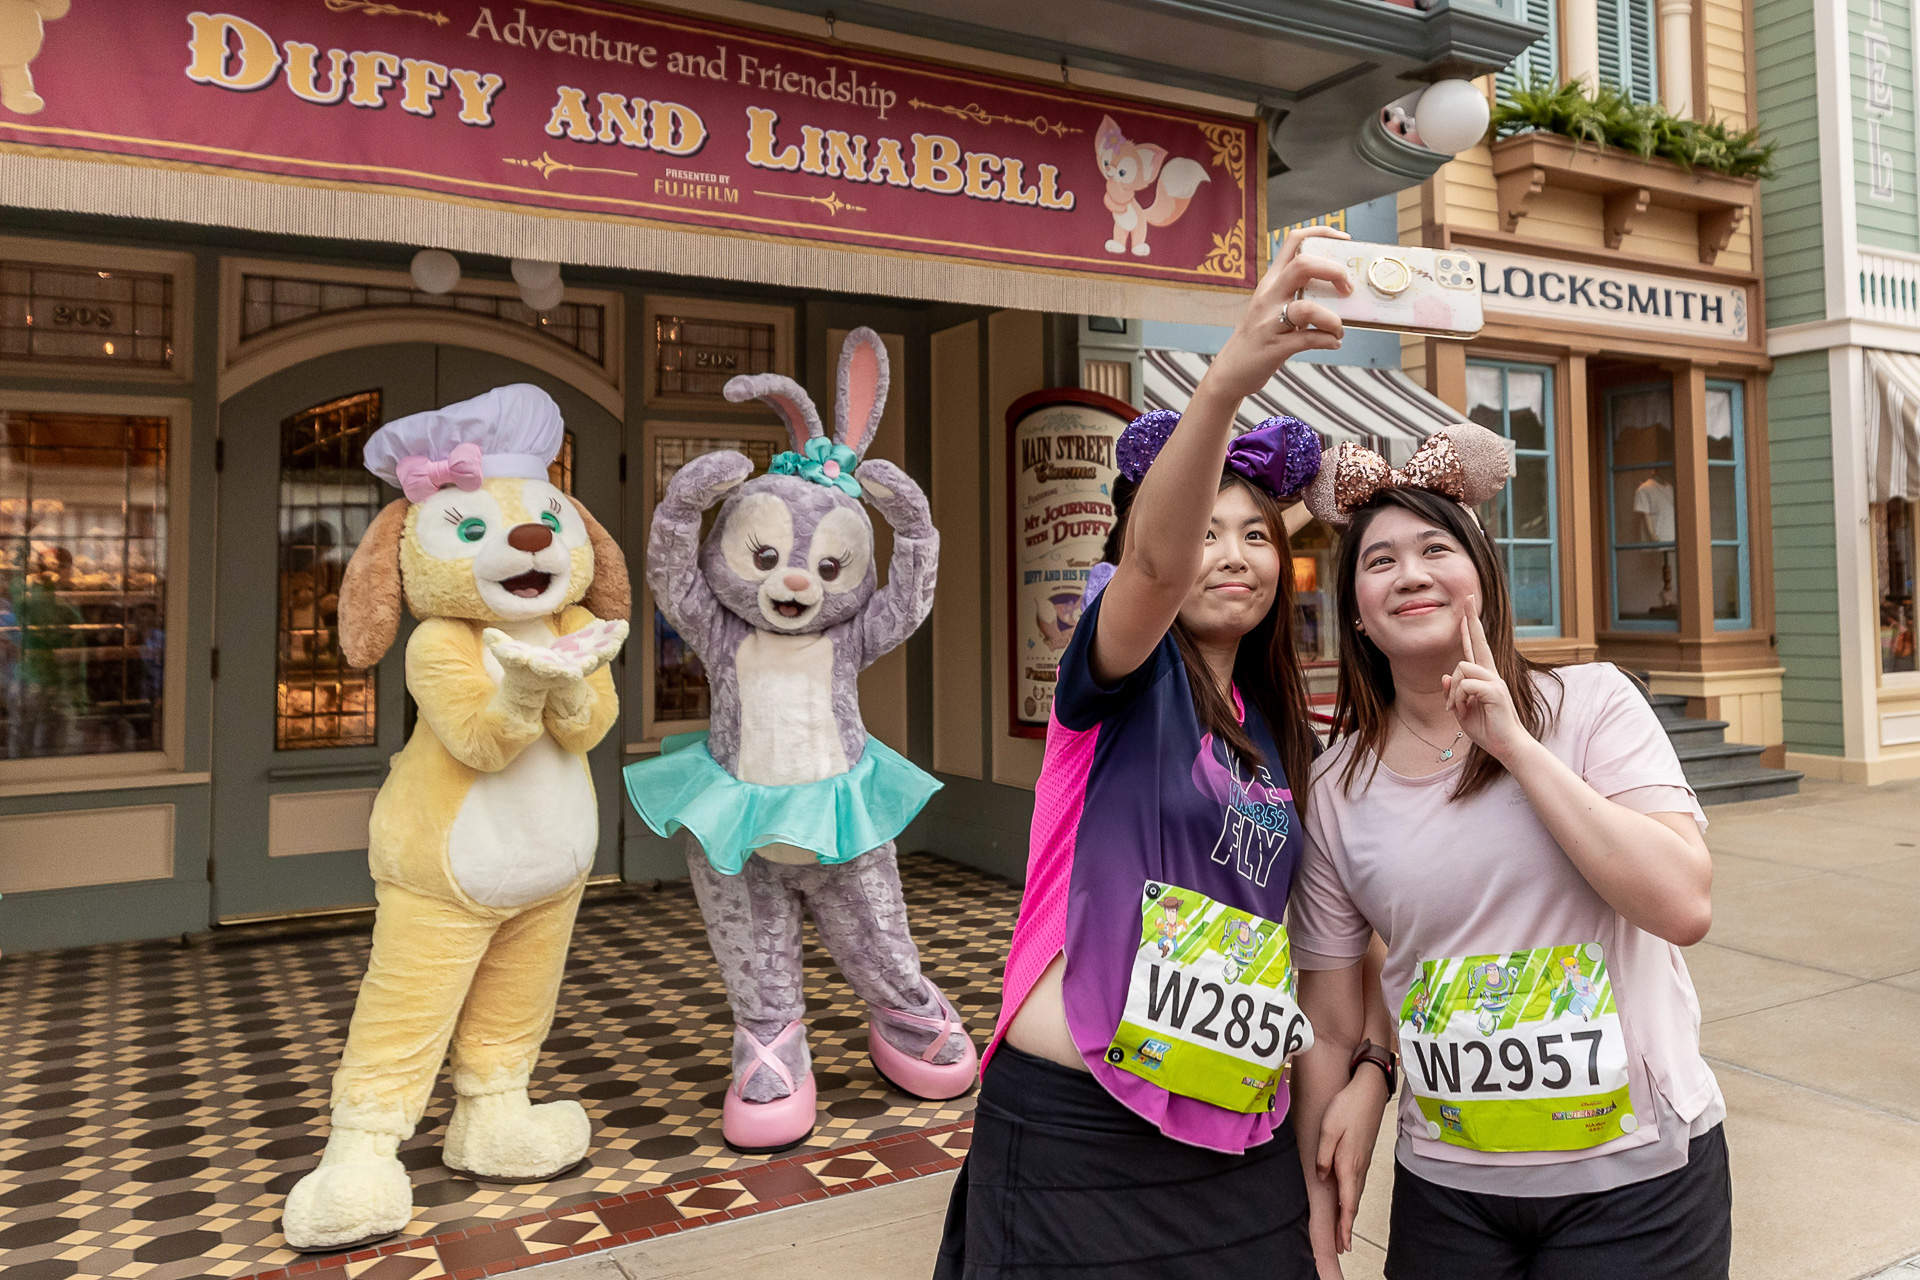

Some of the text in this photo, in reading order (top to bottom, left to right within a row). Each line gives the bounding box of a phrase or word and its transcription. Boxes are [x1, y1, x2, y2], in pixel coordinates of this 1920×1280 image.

[467, 7, 897, 120] Adventure and Friendship
[185, 12, 503, 126] DUFFY
[545, 85, 707, 157] AND
[654, 179, 739, 203] FUJIFILM
[665, 167, 730, 184] PRESENTED BY
[1479, 261, 1724, 324] LOCKSMITH
[1021, 434, 1114, 473] MAIN STREET
[1034, 461, 1097, 484] Cinema
[1042, 501, 1113, 525] JOURNEYS
[1052, 519, 1112, 545] DUFFY
[1062, 569, 1078, 581] HIS
[1211, 804, 1287, 888] FLY
[1147, 964, 1306, 1058] W2856
[1412, 1029, 1604, 1093] W2957
